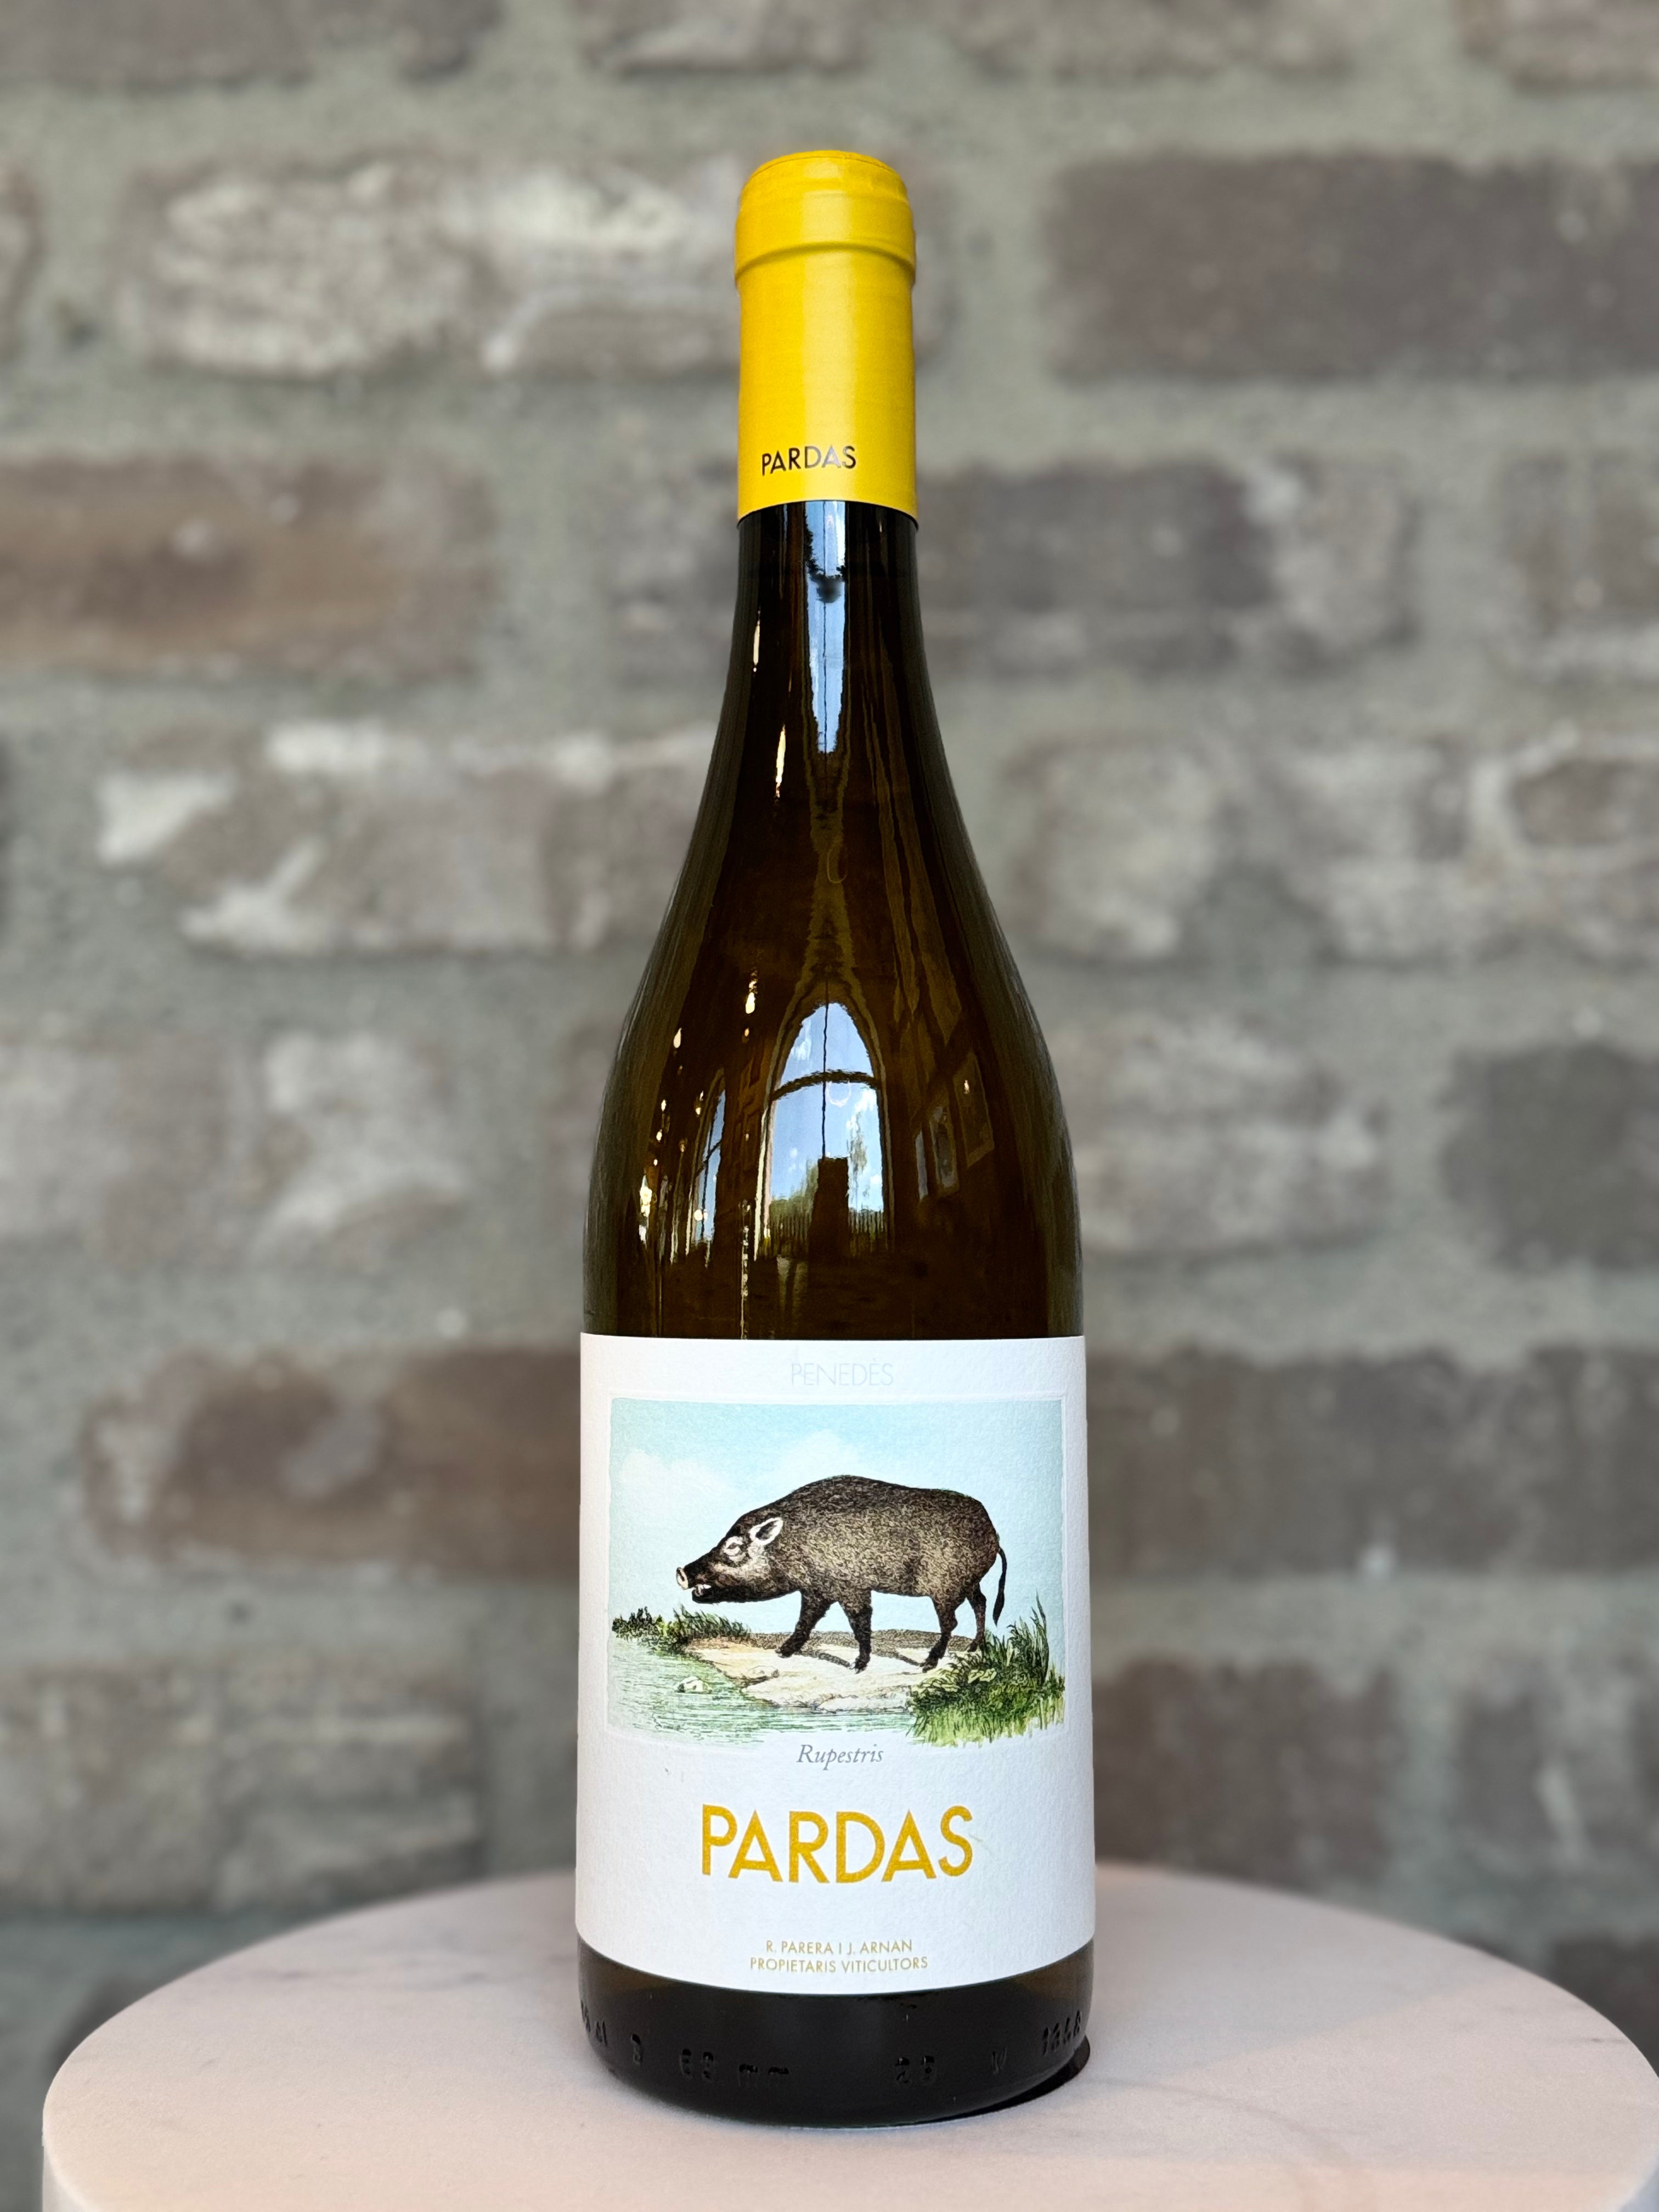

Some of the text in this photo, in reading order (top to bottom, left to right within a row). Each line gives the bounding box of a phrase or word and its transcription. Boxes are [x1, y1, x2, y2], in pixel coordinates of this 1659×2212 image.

[761, 445, 856, 476] PARDAS
[791, 1357, 894, 1386] PENEDÈS
[797, 1743, 884, 1771] Rupestris
[702, 1803, 973, 1884] PARDAS
[766, 1939, 777, 1953] R.
[781, 1940, 834, 1955] PARERA
[847, 1942, 856, 1955] J.
[860, 1939, 913, 1954] ARNAN
[750, 1956, 928, 1974] PROPIETARIS VITICULTORS
